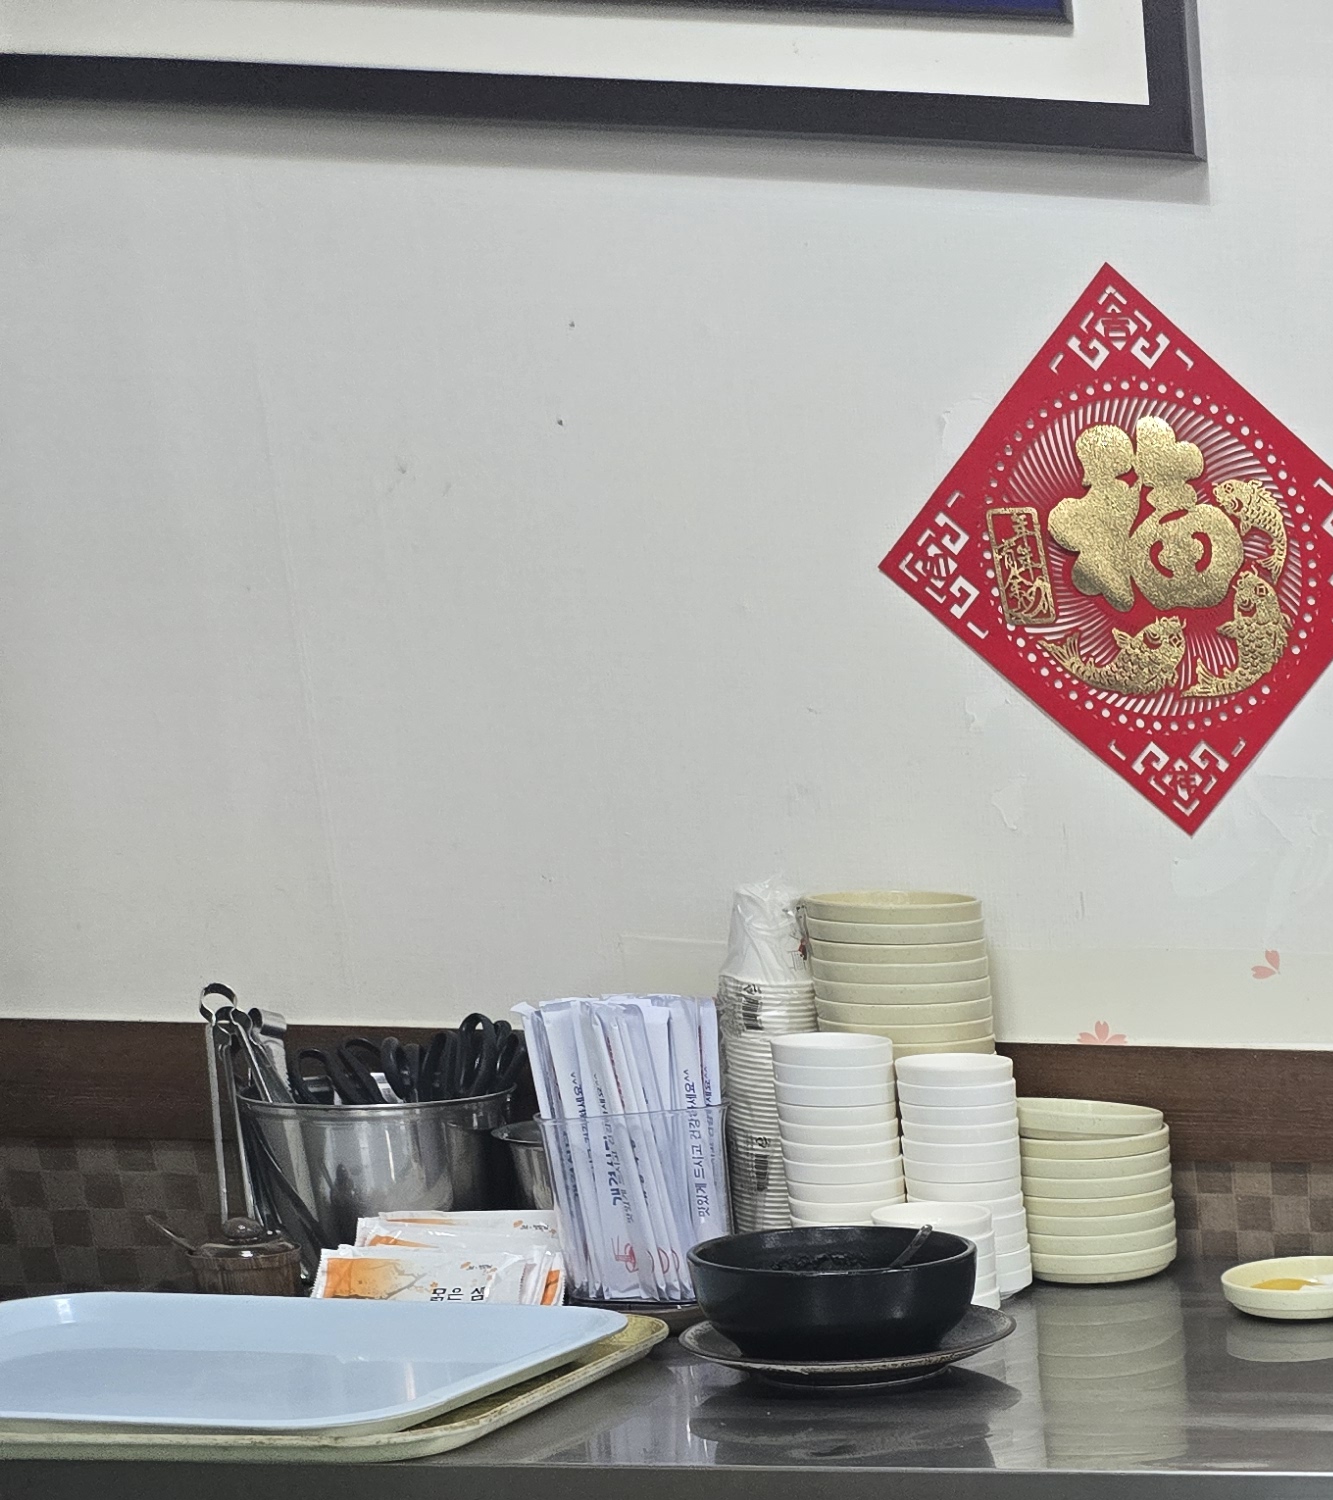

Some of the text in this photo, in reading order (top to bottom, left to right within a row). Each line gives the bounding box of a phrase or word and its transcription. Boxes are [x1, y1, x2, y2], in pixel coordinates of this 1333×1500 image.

[1047, 414, 1244, 613] 福
[690, 1143, 706, 1180] 드시고
[692, 1182, 711, 1218] 맛있게
